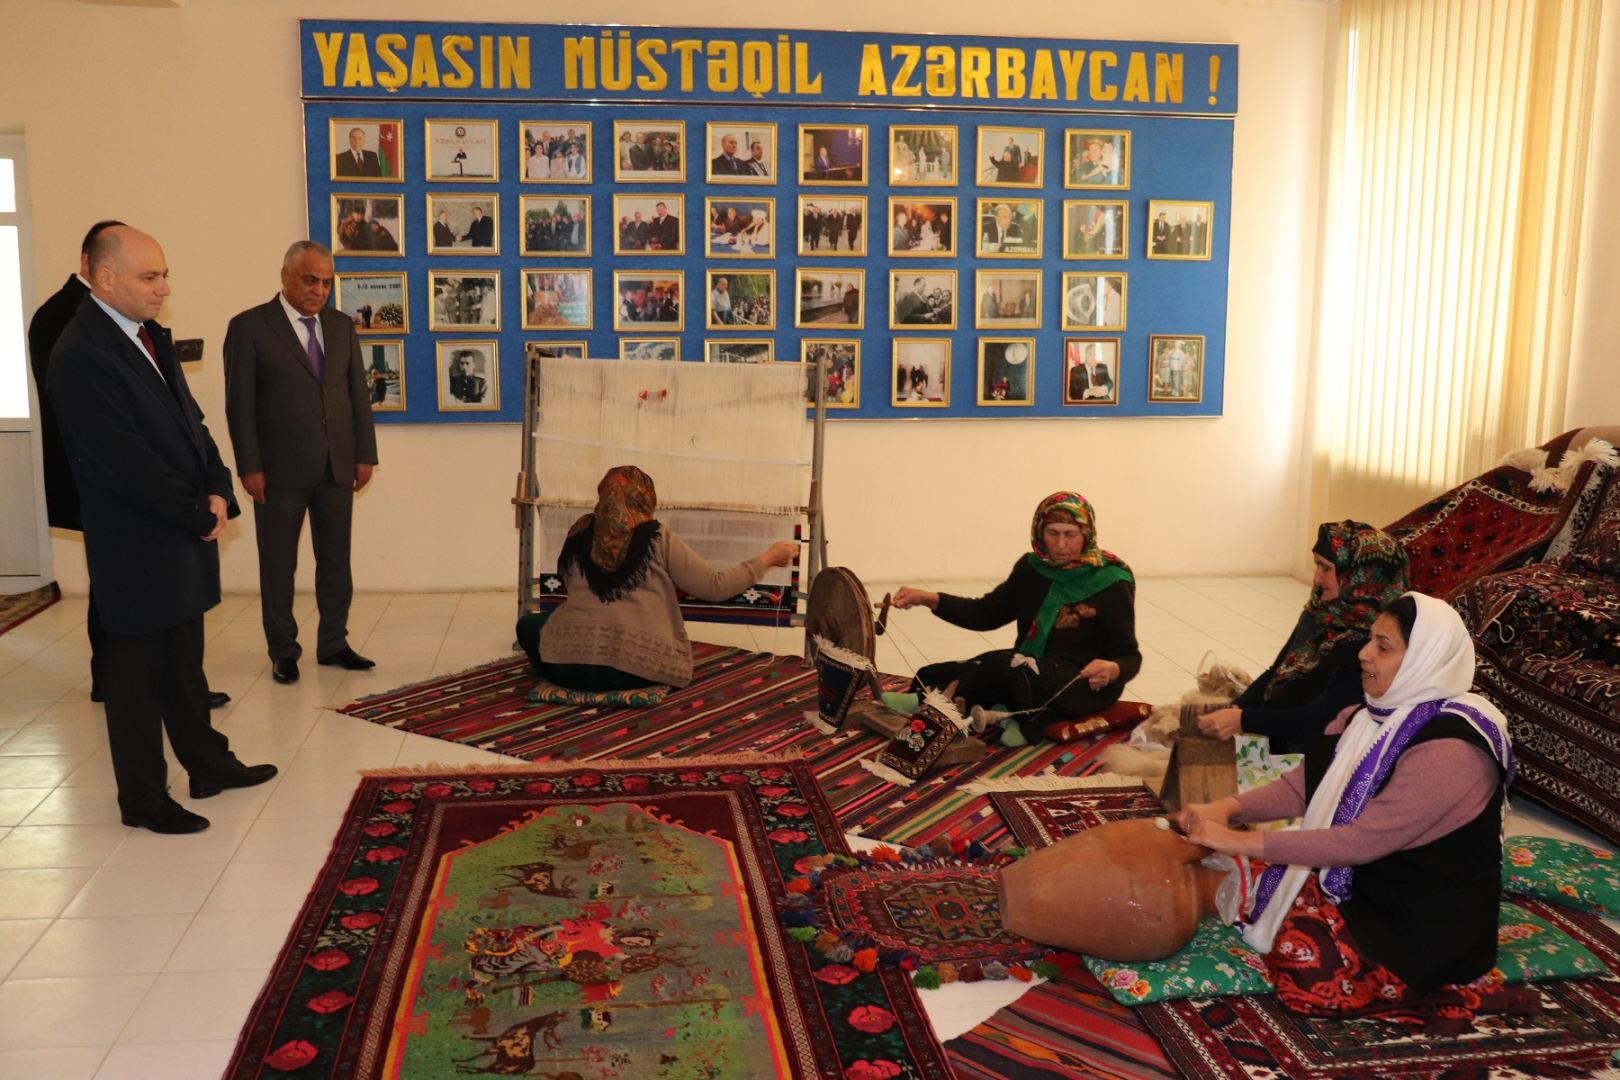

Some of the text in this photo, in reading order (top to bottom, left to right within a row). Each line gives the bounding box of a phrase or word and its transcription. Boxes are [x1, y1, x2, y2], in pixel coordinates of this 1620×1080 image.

[312, 30, 1221, 105] YAŞASIN MÜSTƏQİL AZƏRBAYCAN !
